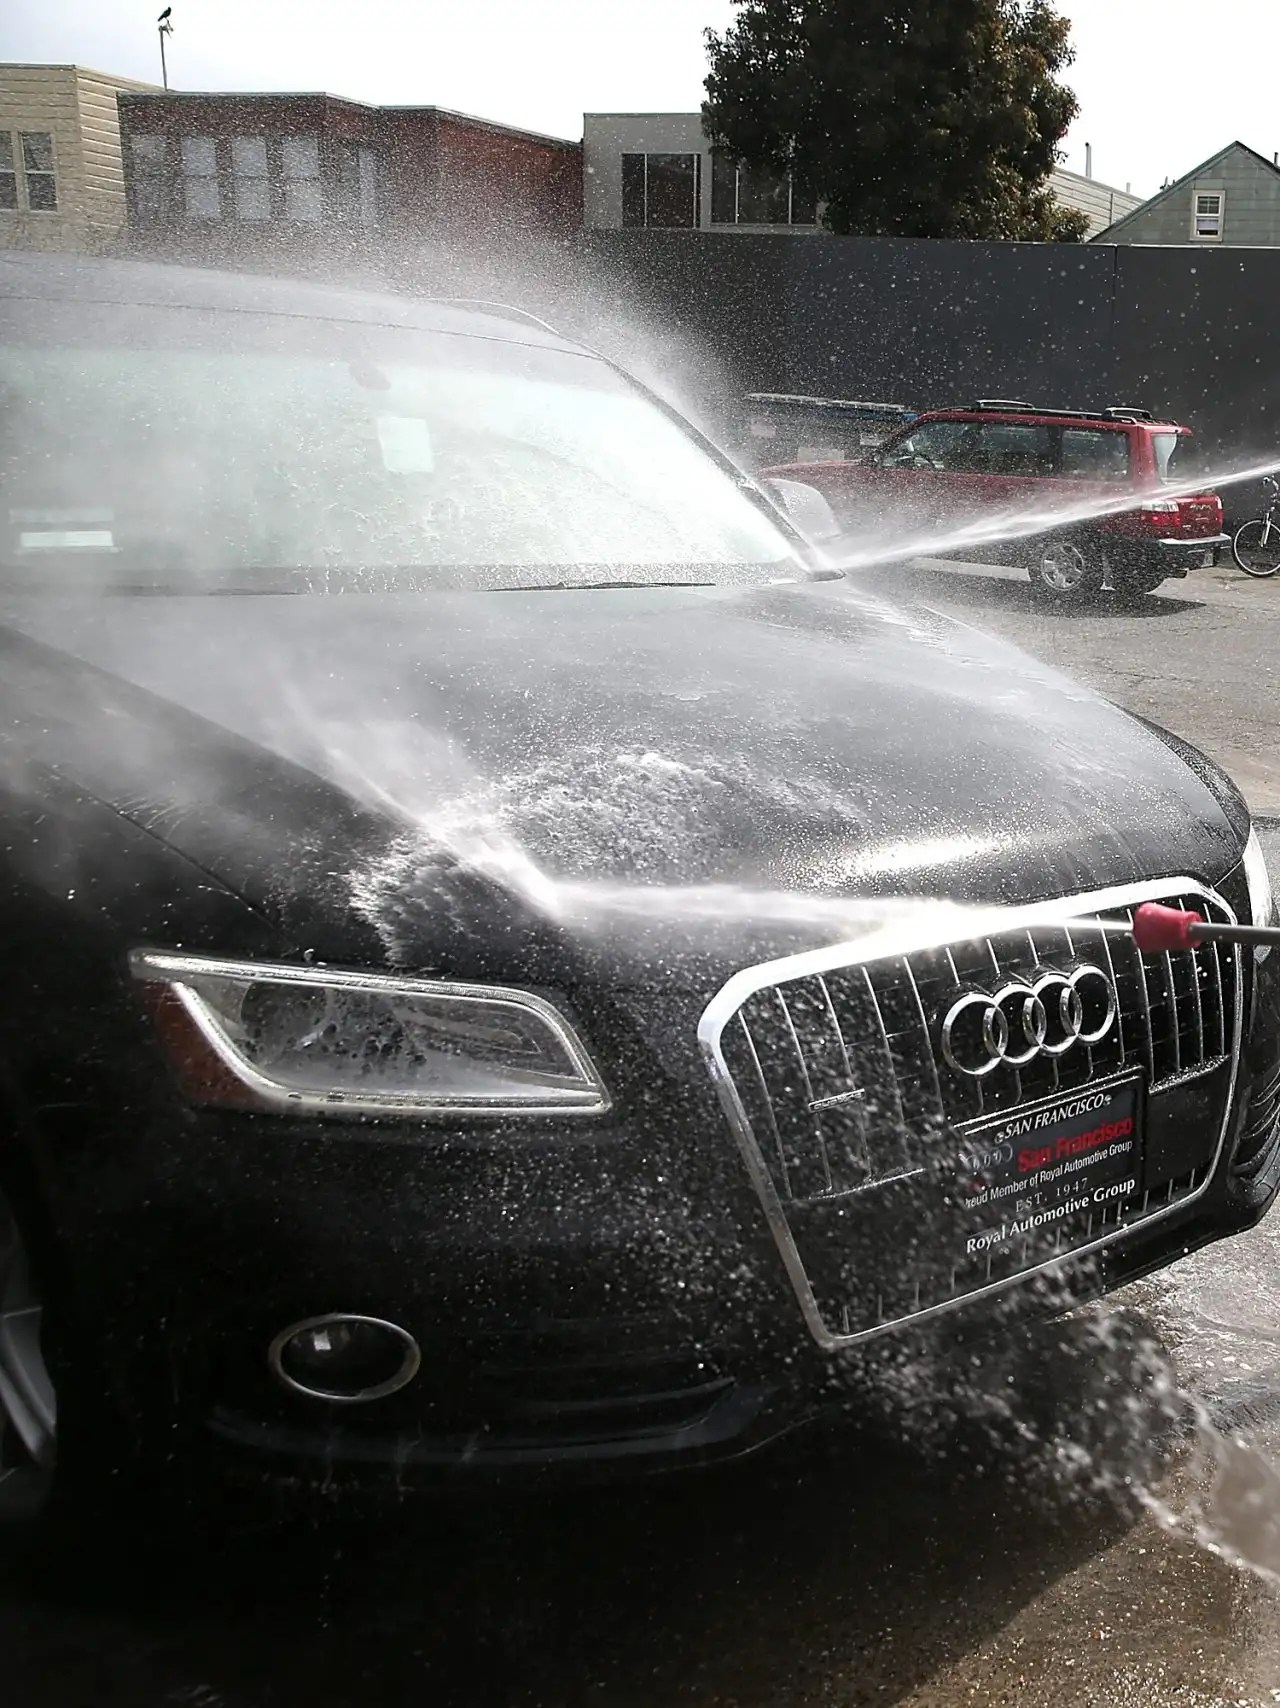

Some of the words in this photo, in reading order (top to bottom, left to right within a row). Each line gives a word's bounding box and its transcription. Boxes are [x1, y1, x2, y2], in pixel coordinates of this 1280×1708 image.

[1004, 1117, 1031, 1139] SAN
[1034, 1094, 1104, 1129] FRANCISCO
[990, 1179, 1028, 1201] Member
[1030, 1175, 1039, 1188] of
[1040, 1166, 1063, 1184] Royal
[1064, 1150, 1108, 1174] Automotive
[1109, 1140, 1133, 1157] Group
[1018, 1146, 1052, 1172] San
[1057, 1117, 1133, 1159] Francisco
[1056, 1178, 1088, 1197] 1947
[966, 1225, 1006, 1253] Royal
[1010, 1197, 1089, 1237] Automotive
[1093, 1178, 1136, 1203] Group
